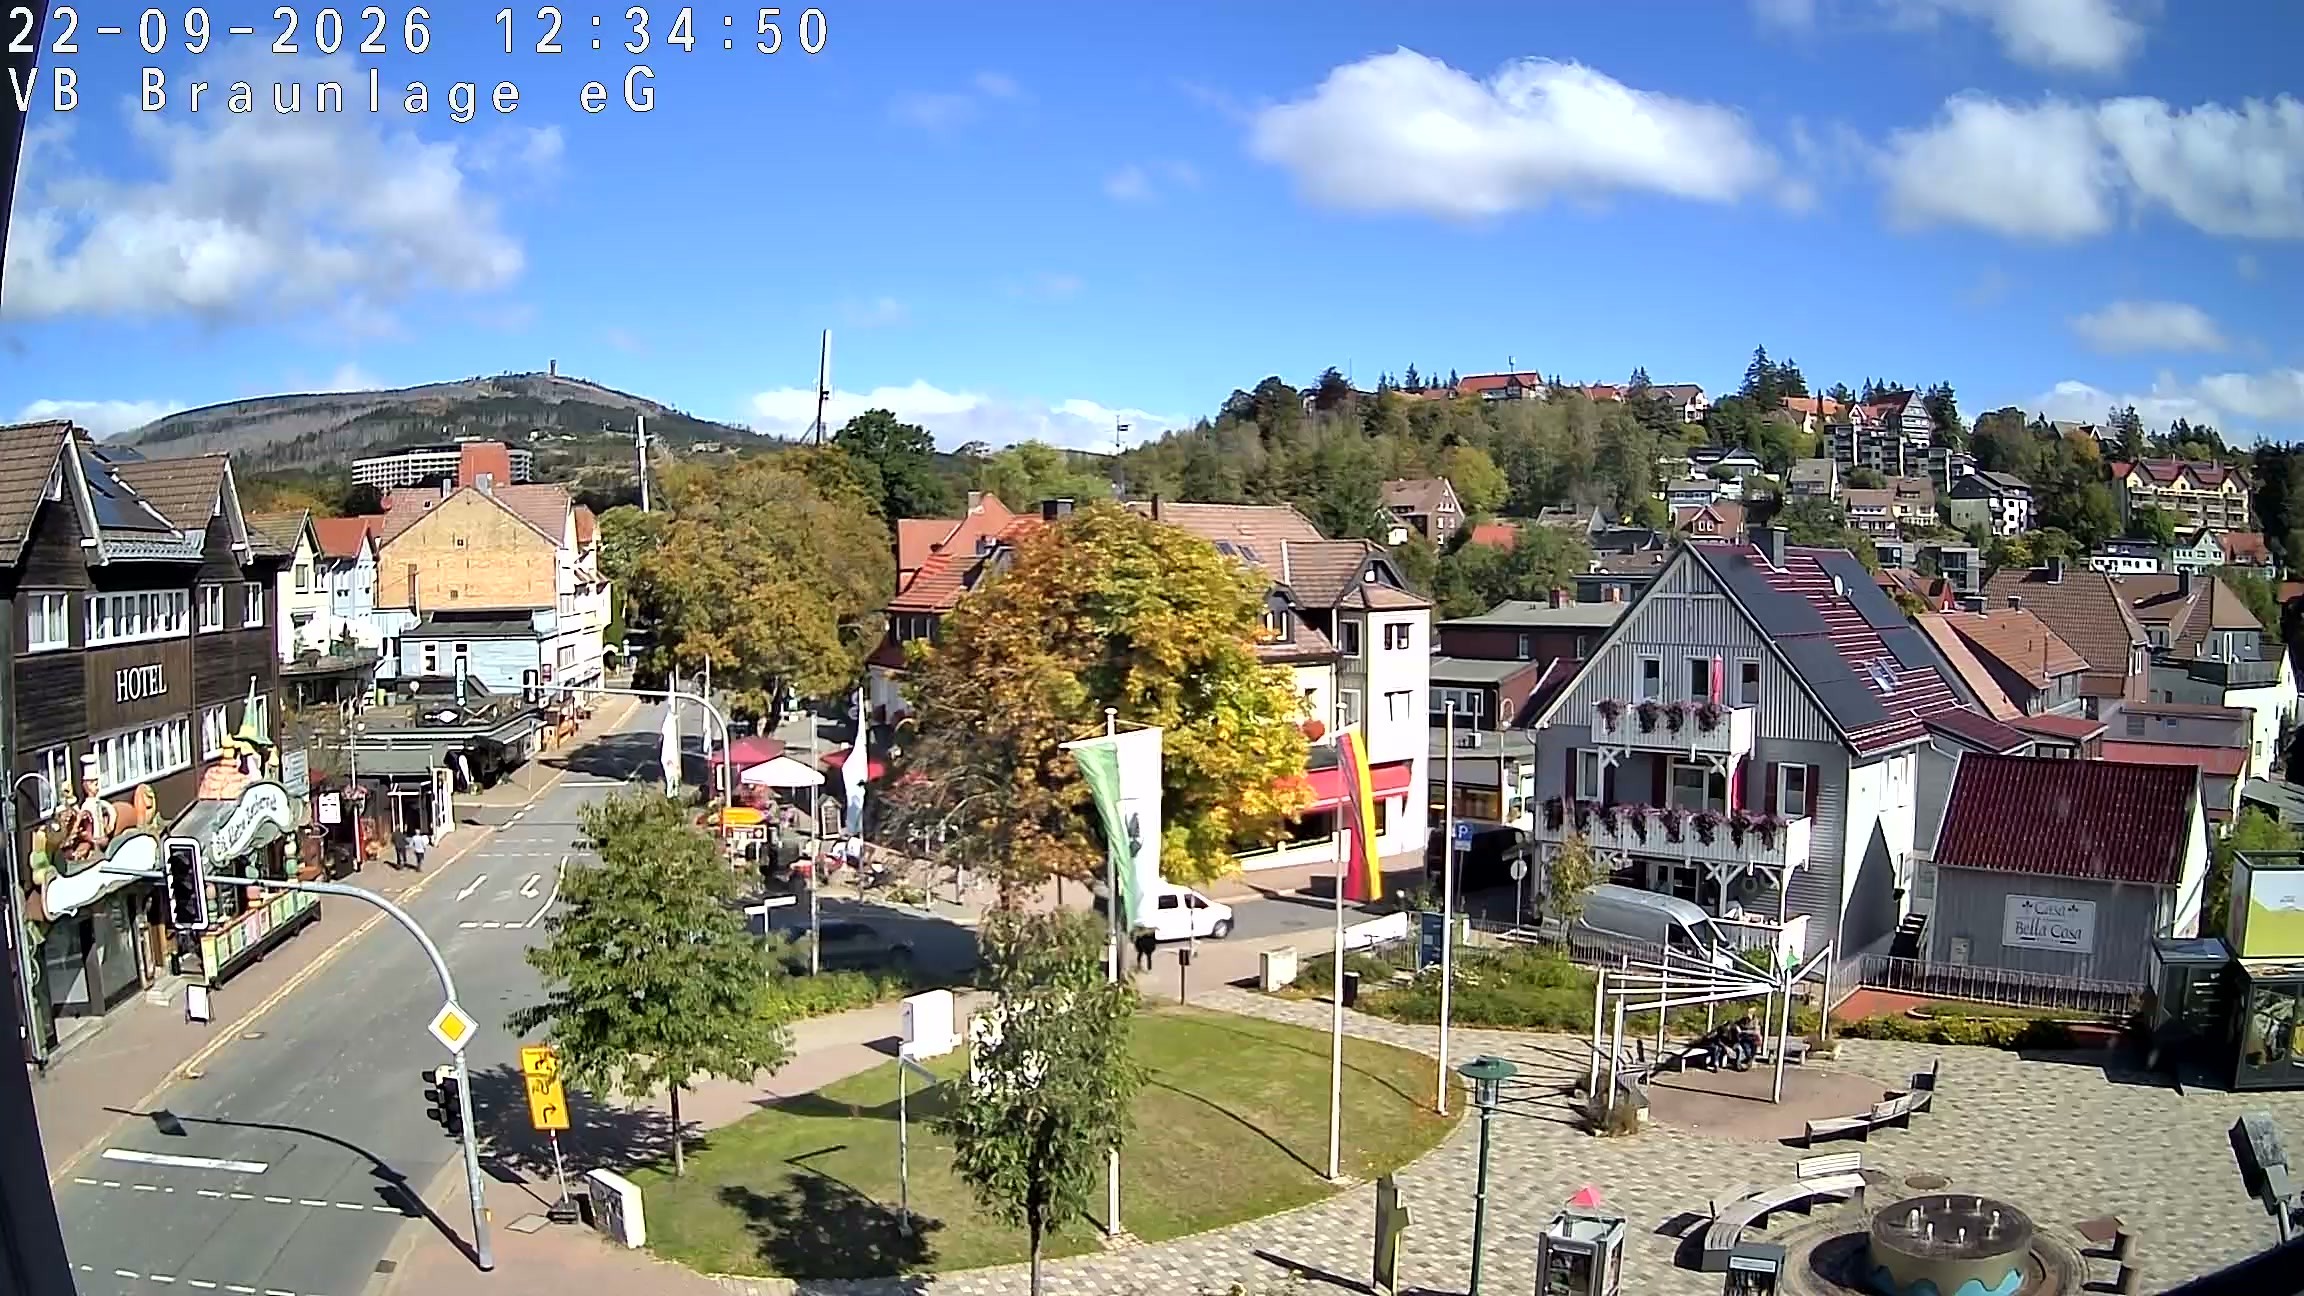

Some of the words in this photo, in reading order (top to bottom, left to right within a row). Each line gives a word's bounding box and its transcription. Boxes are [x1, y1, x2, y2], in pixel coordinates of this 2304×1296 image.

[116, 664, 168, 703] HOTEL
[2016, 918, 2048, 936] Bella
[2050, 924, 2082, 940] Casa
